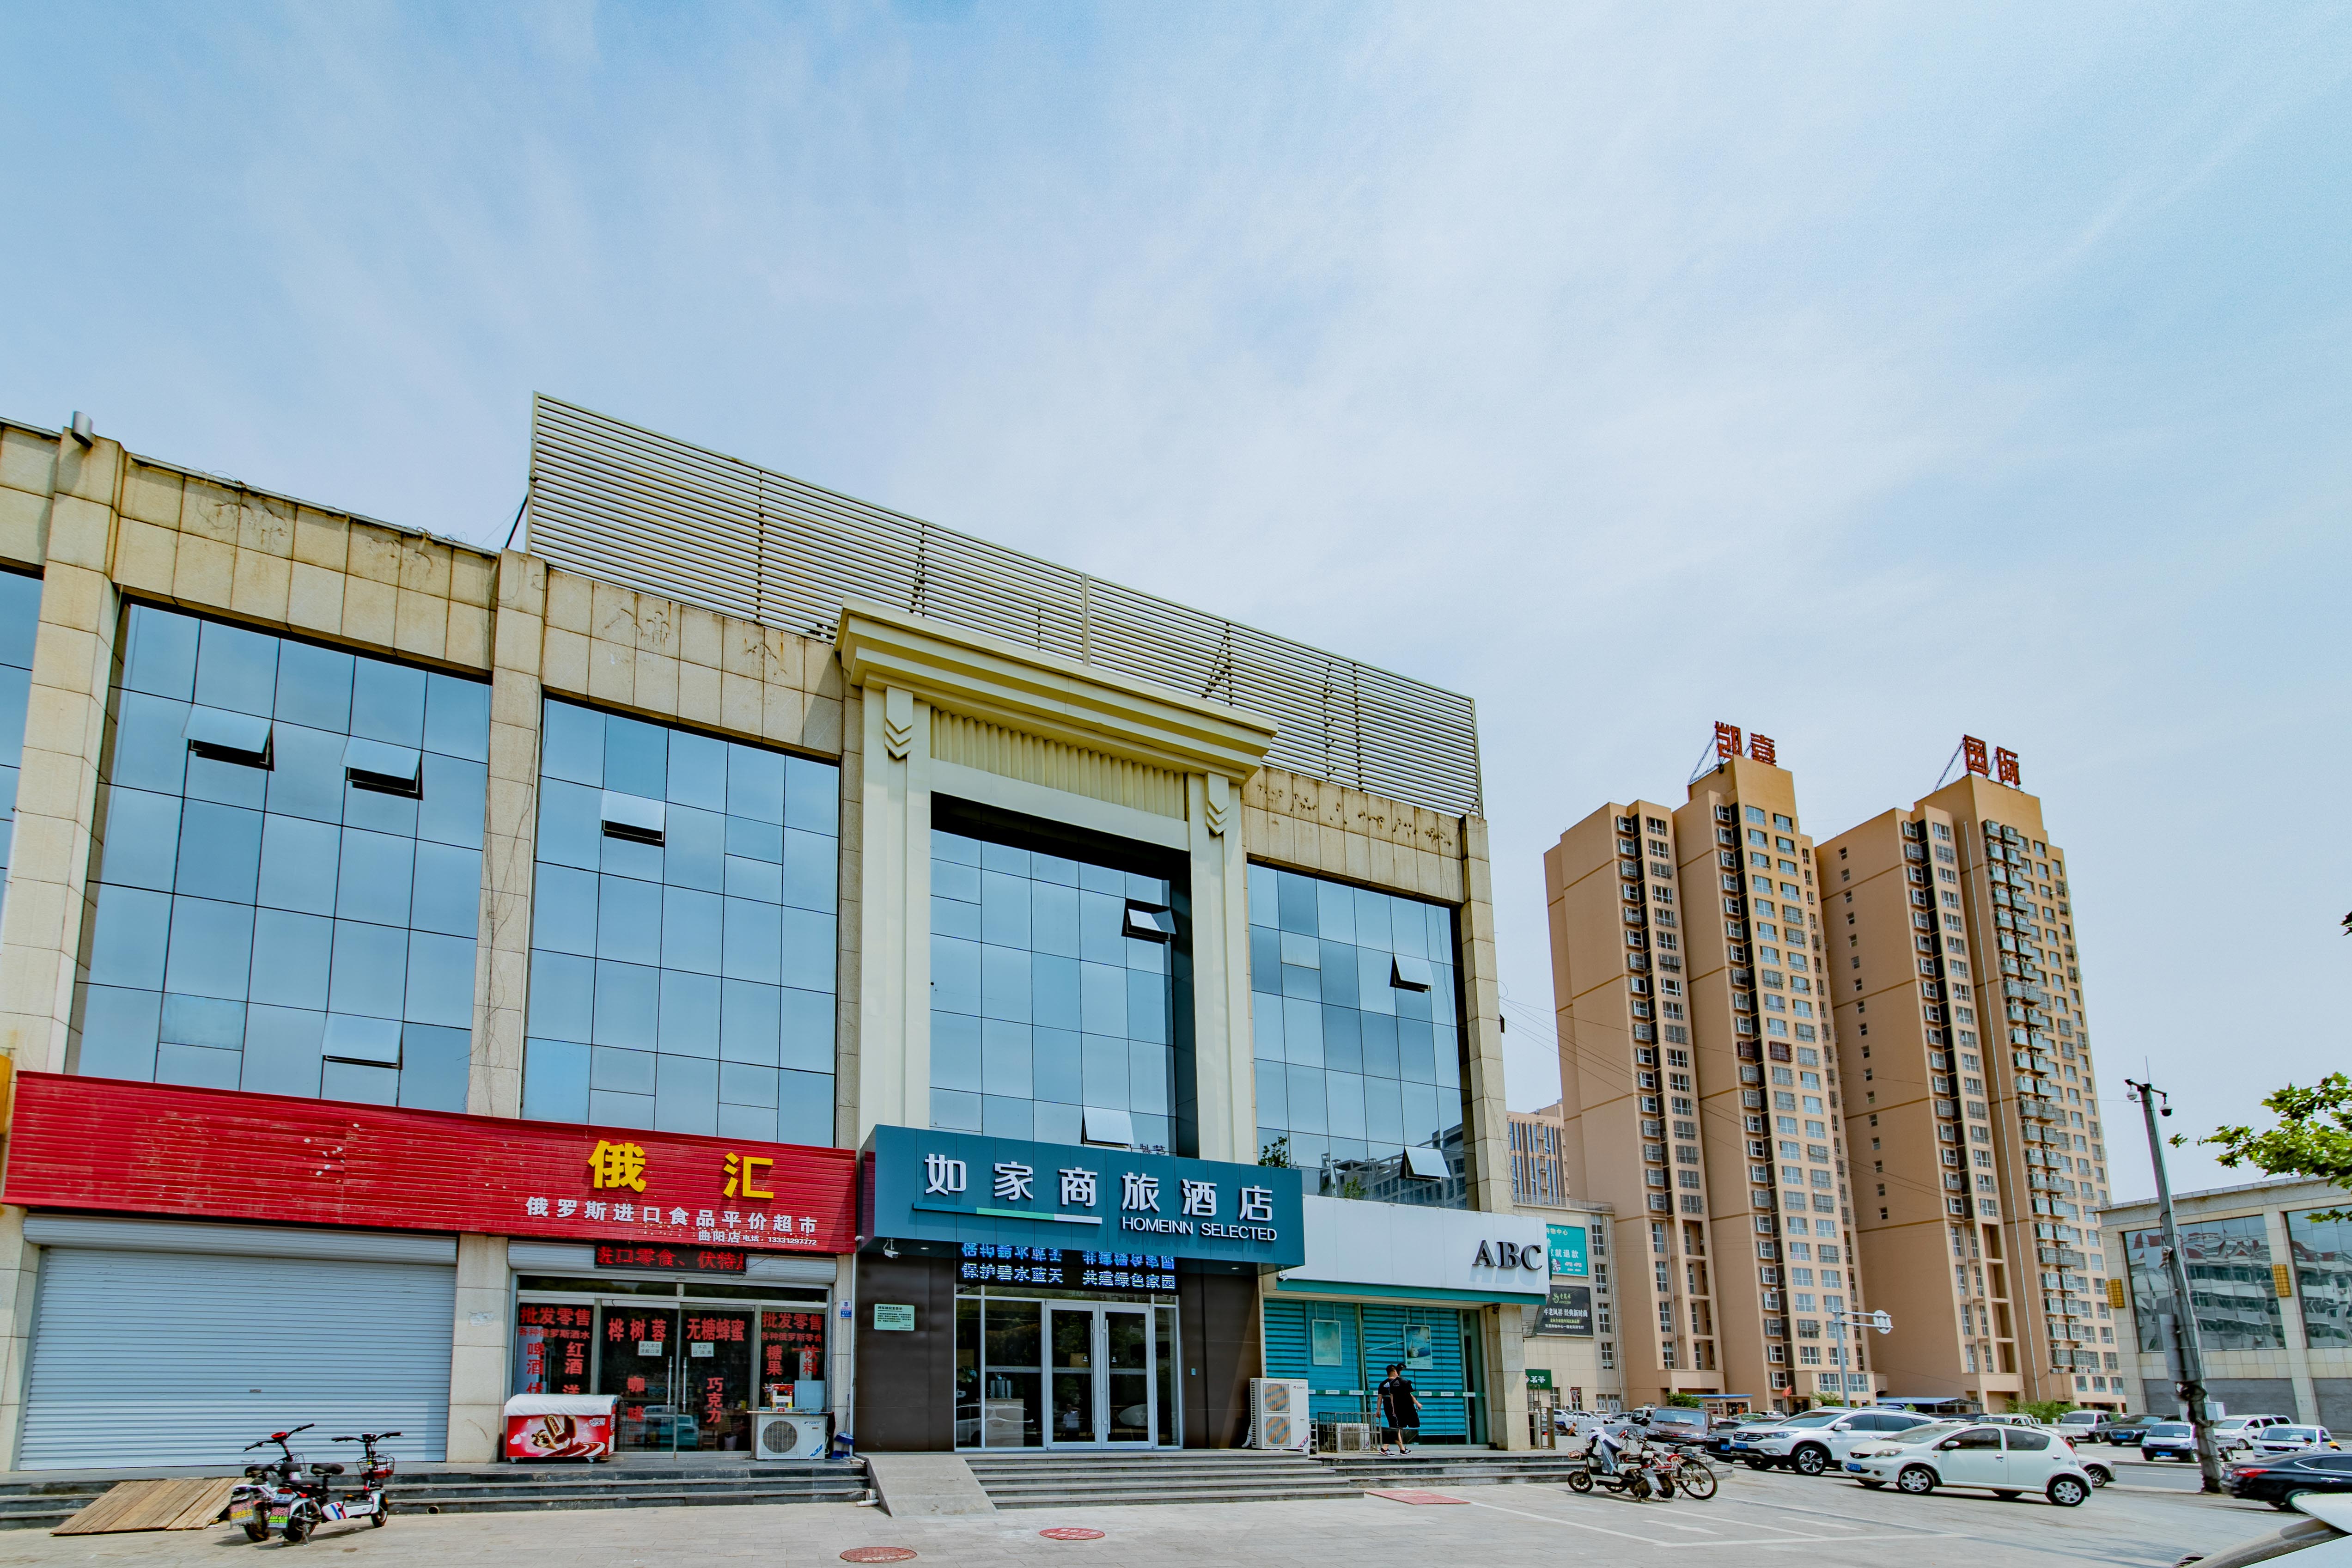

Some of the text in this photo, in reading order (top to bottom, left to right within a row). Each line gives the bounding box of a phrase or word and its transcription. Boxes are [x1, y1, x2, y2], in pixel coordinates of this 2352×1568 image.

[1963, 734, 2021, 786] 国际
[925, 1153, 1273, 1221] 如家商旅酒店
[525, 1196, 817, 1234] 俄罗斯进口食品平价超市
[1122, 1216, 1277, 1241] HOMEINN SELECTED
[698, 1230, 740, 1243] 曲阳店
[768, 1237, 817, 1245] 13331297772
[1472, 1240, 1542, 1270] ABC
[961, 1262, 1176, 1289] 保护碧水蓝天 共建绿色家园
[520, 1307, 591, 1326] 批发零售
[687, 1318, 745, 1342] 无糖蜂蜜
[762, 1312, 823, 1330] 批发零售
[518, 1327, 590, 1339] 各种俄罗斯酒水
[762, 1331, 822, 1342] 各种俄罗斯零食
[526, 1342, 545, 1375] 啤酒
[564, 1341, 585, 1375] 红酒
[766, 1344, 783, 1376] 糖果
[803, 1345, 819, 1376] 饮料
[627, 1375, 645, 1422] 咖啡
[706, 1377, 724, 1423] 巧克力
